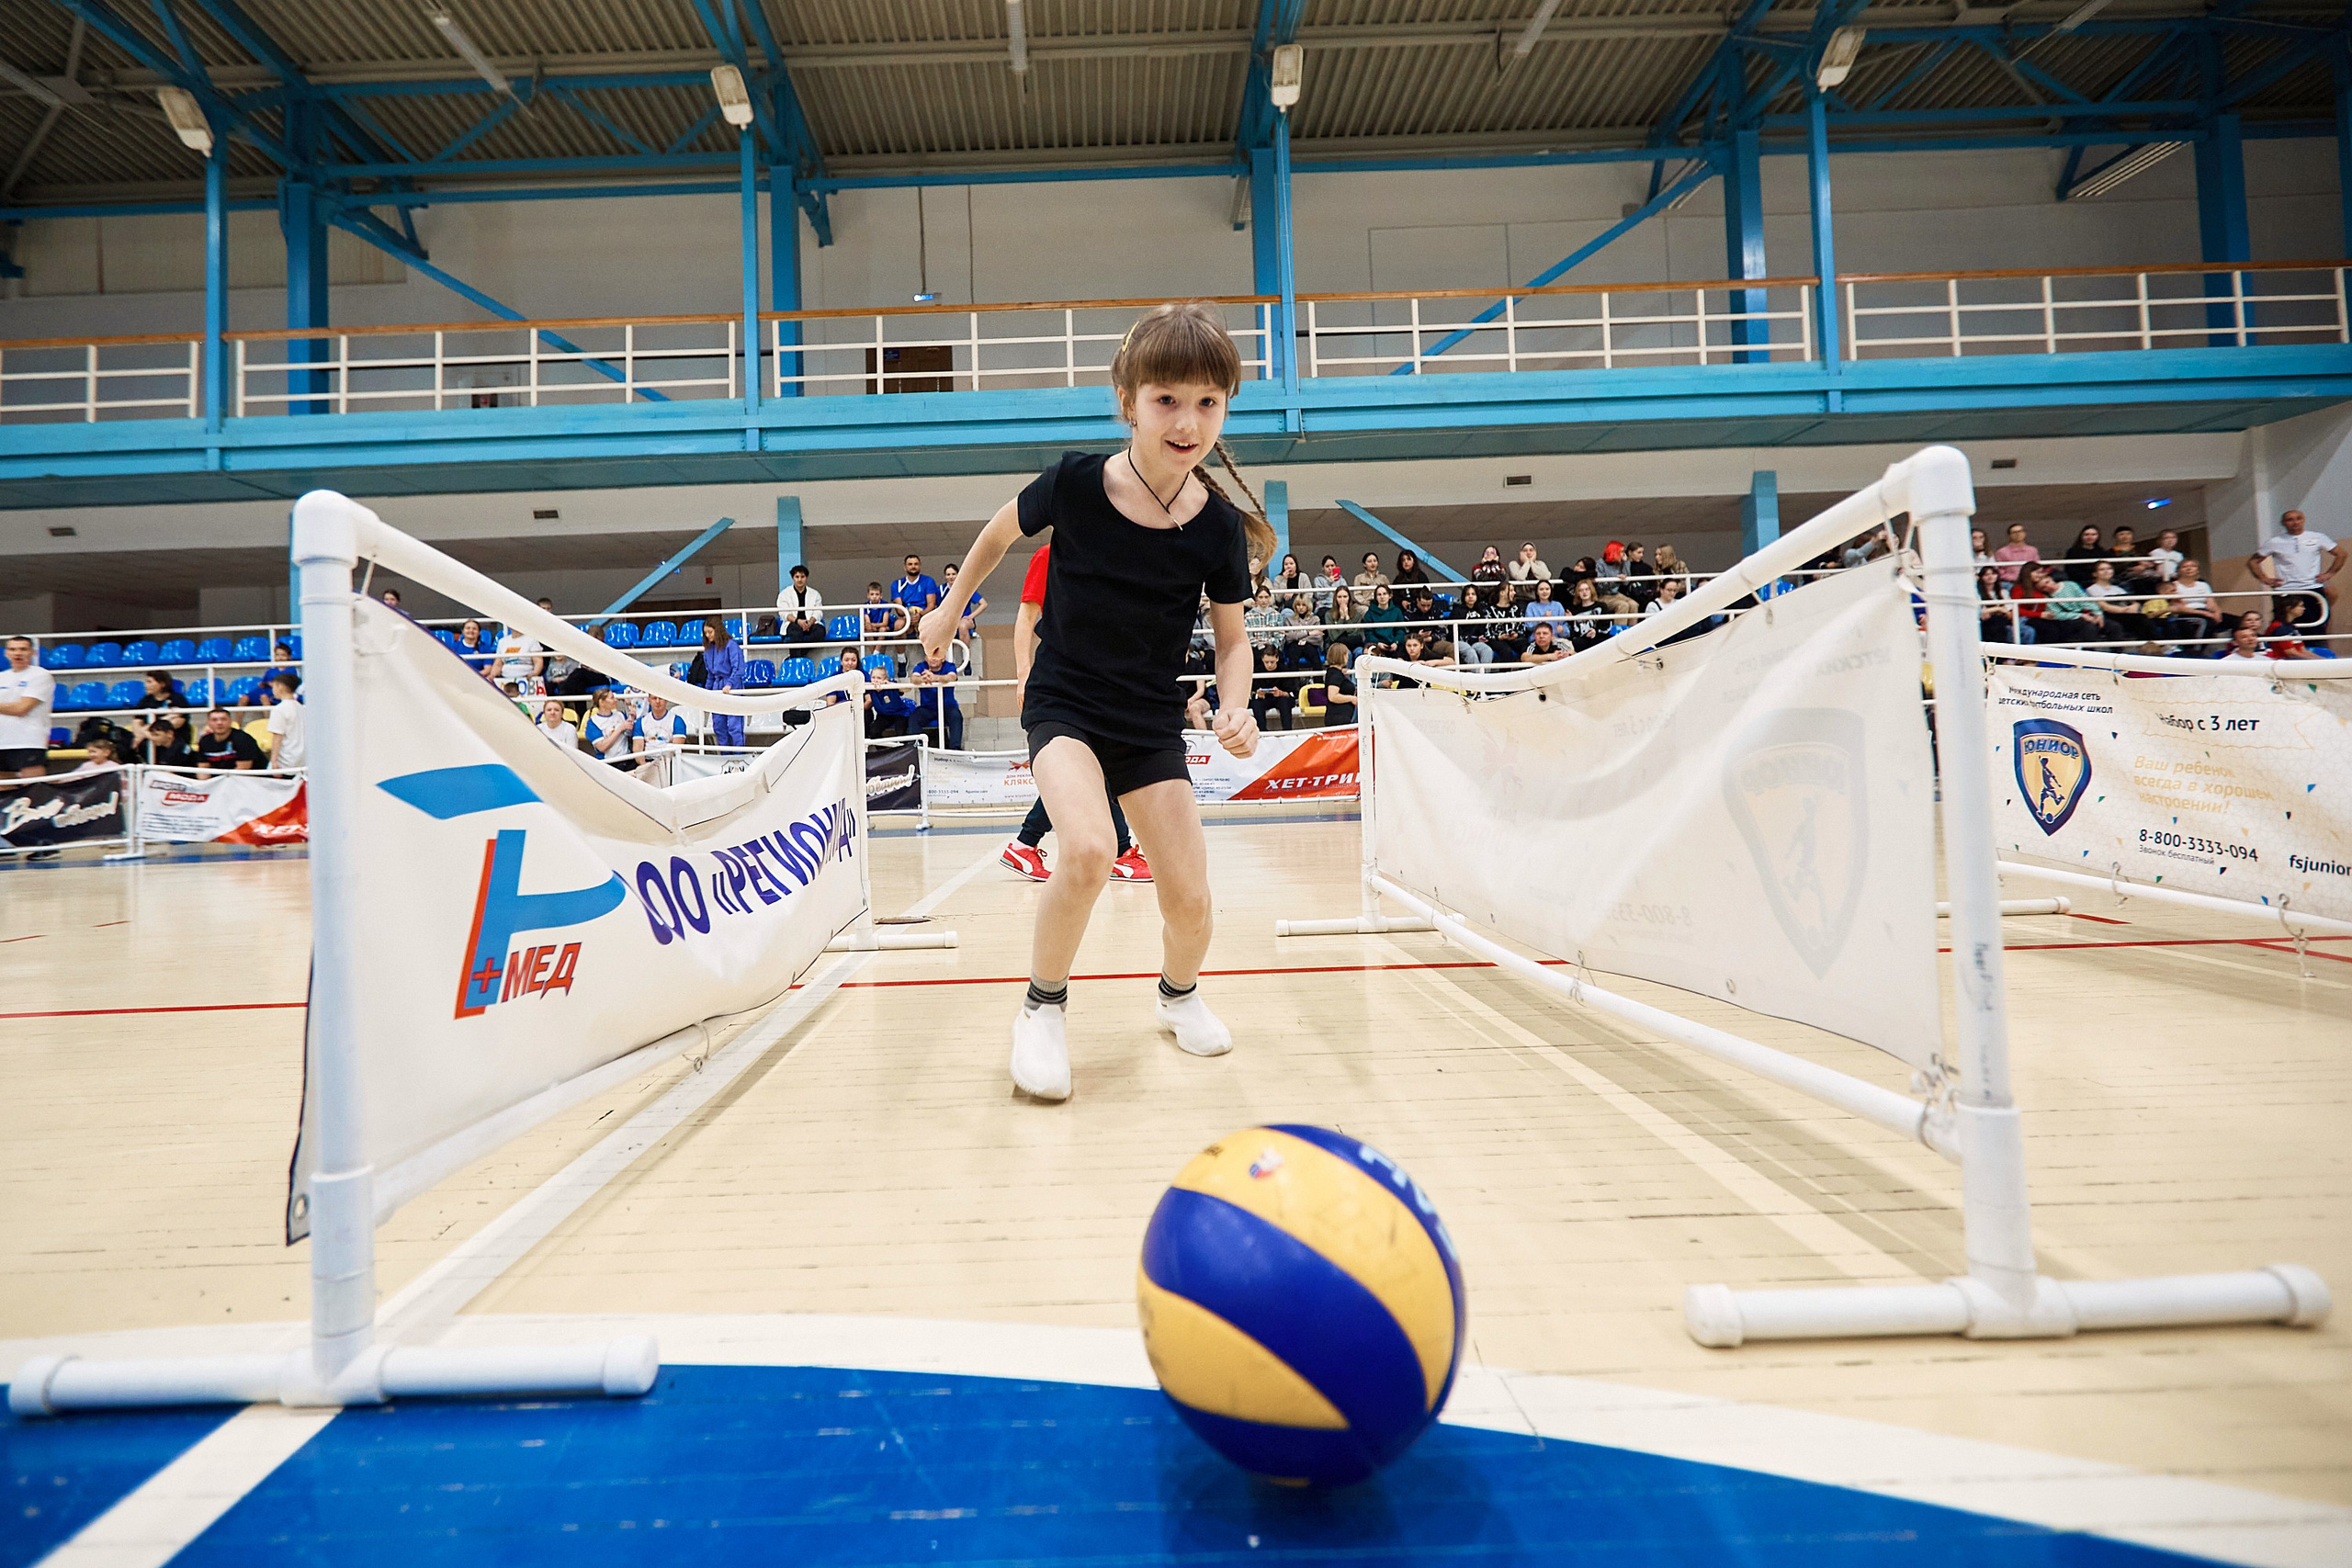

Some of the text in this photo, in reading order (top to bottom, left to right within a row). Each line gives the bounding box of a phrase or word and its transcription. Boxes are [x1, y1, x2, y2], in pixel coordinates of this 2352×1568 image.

[2081, 693, 2101, 701] сеть
[2086, 705, 2113, 714] школ
[2197, 718, 2206, 731] с
[2210, 716, 2221, 731] 3
[2224, 719, 2260, 731] лет
[2024, 738, 2080, 760] ЮНИОР
[2134, 755, 2169, 772] Ваш
[1003, 778, 1035, 786] КЛЯКС
[2133, 775, 2183, 791] всегда
[2188, 782, 2199, 792] в
[2139, 829, 2259, 863] 8-800-3333-094
